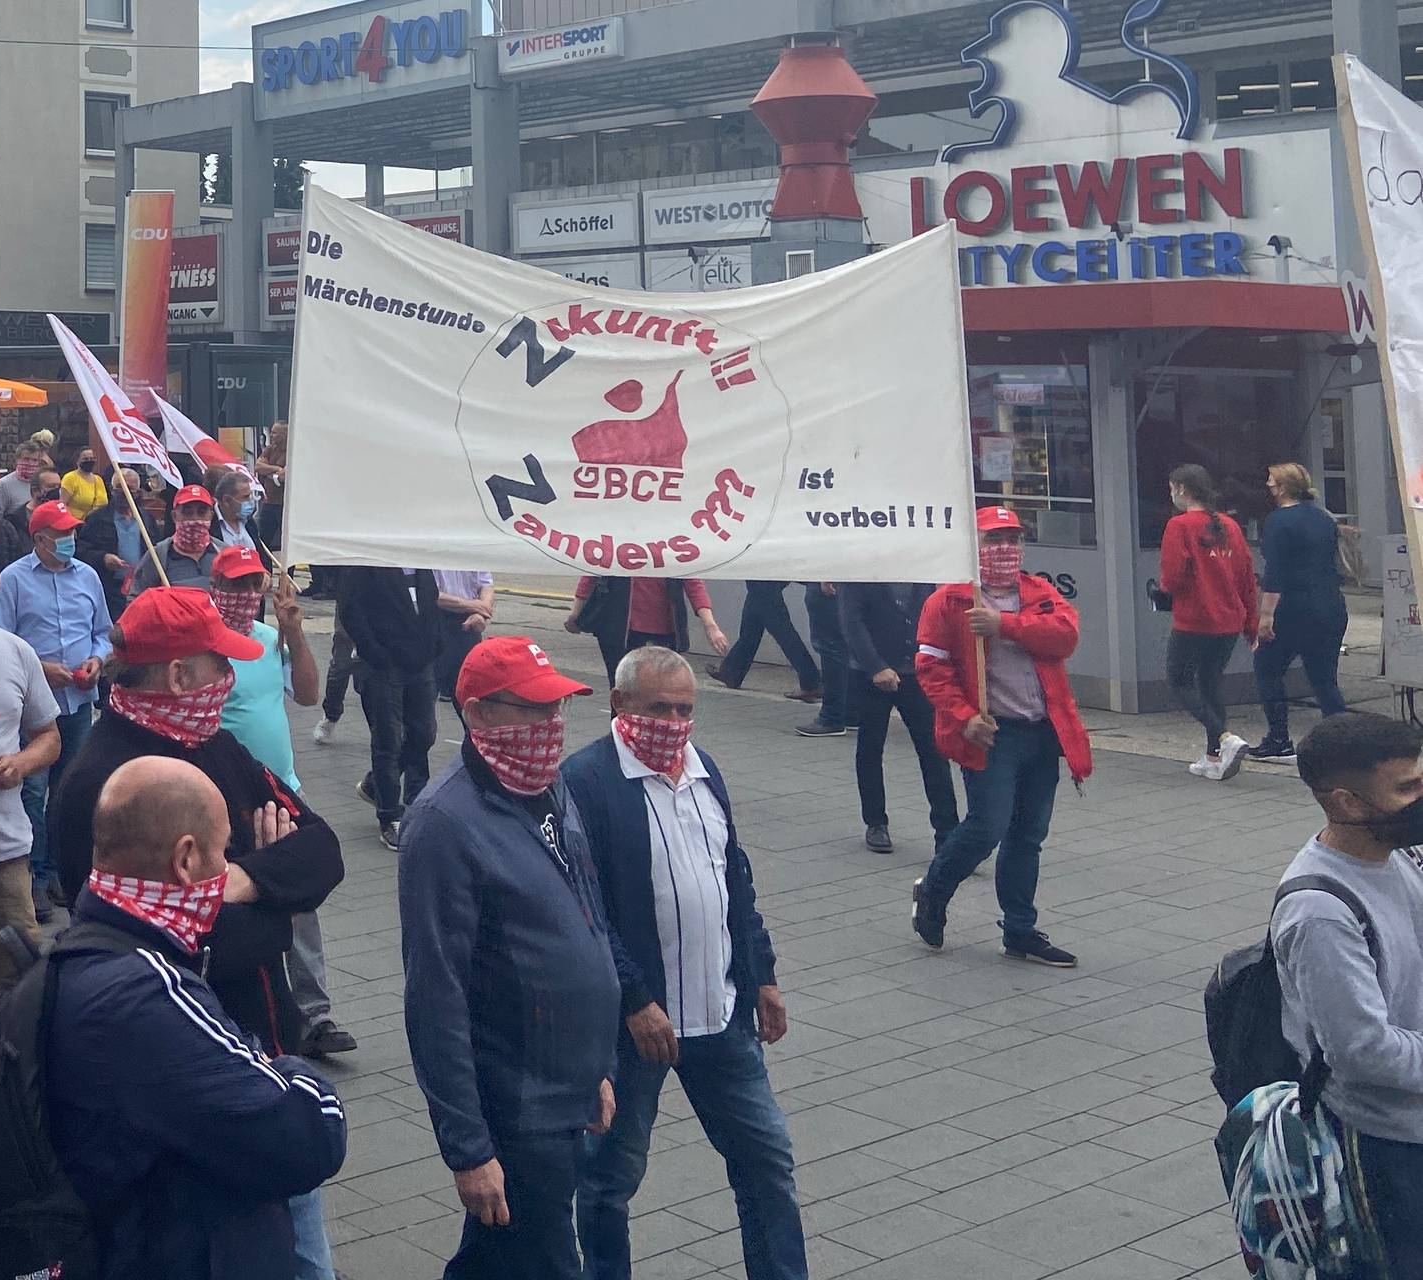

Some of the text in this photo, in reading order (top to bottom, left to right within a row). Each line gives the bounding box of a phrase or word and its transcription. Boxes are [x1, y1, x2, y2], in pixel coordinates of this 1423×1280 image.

[521, 24, 609, 55] INTERSPORT
[563, 46, 607, 59] GRUPPE
[911, 148, 1245, 237] LOEWEN
[554, 214, 614, 233] Schöffel
[655, 206, 702, 225] WEST
[131, 229, 168, 241] CDU
[307, 231, 343, 260] Die
[169, 268, 216, 289] TNESS
[167, 308, 197, 320] NGANG
[304, 275, 486, 333] Märchenstunde
[217, 377, 247, 390] CDU
[806, 506, 897, 528] vorbei
